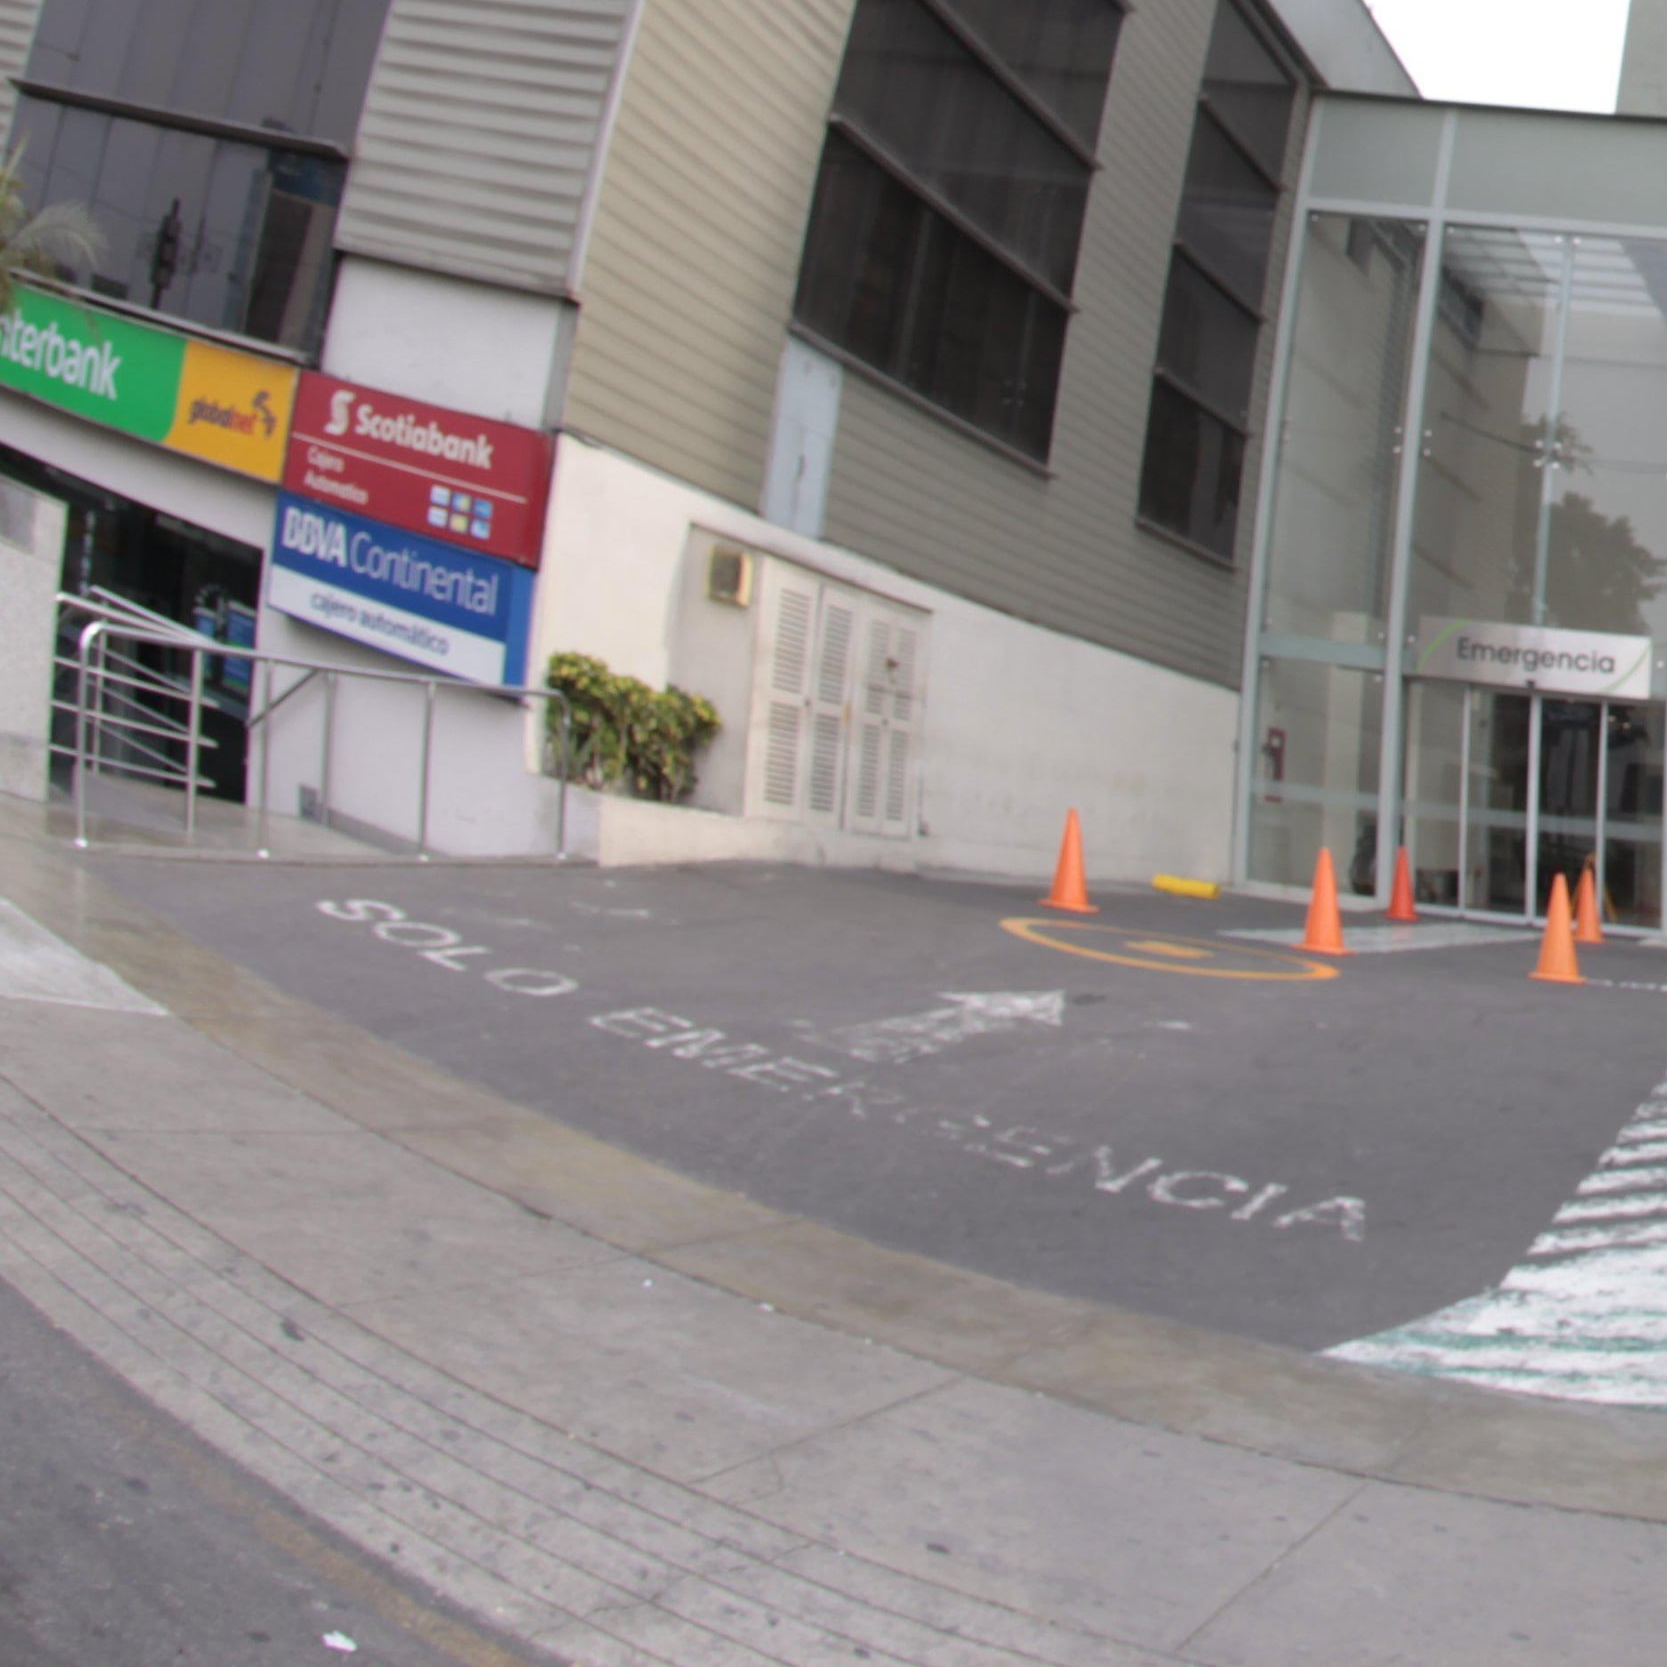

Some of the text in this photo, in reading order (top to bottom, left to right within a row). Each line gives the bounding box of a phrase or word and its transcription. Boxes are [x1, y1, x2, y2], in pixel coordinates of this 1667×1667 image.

[355, 404, 494, 470] Scotiabank
[281, 506, 498, 616] BBVA Continental
[310, 592, 357, 624] cajero
[1456, 636, 1616, 673] Emergencia
[315, 898, 579, 997] SOLO
